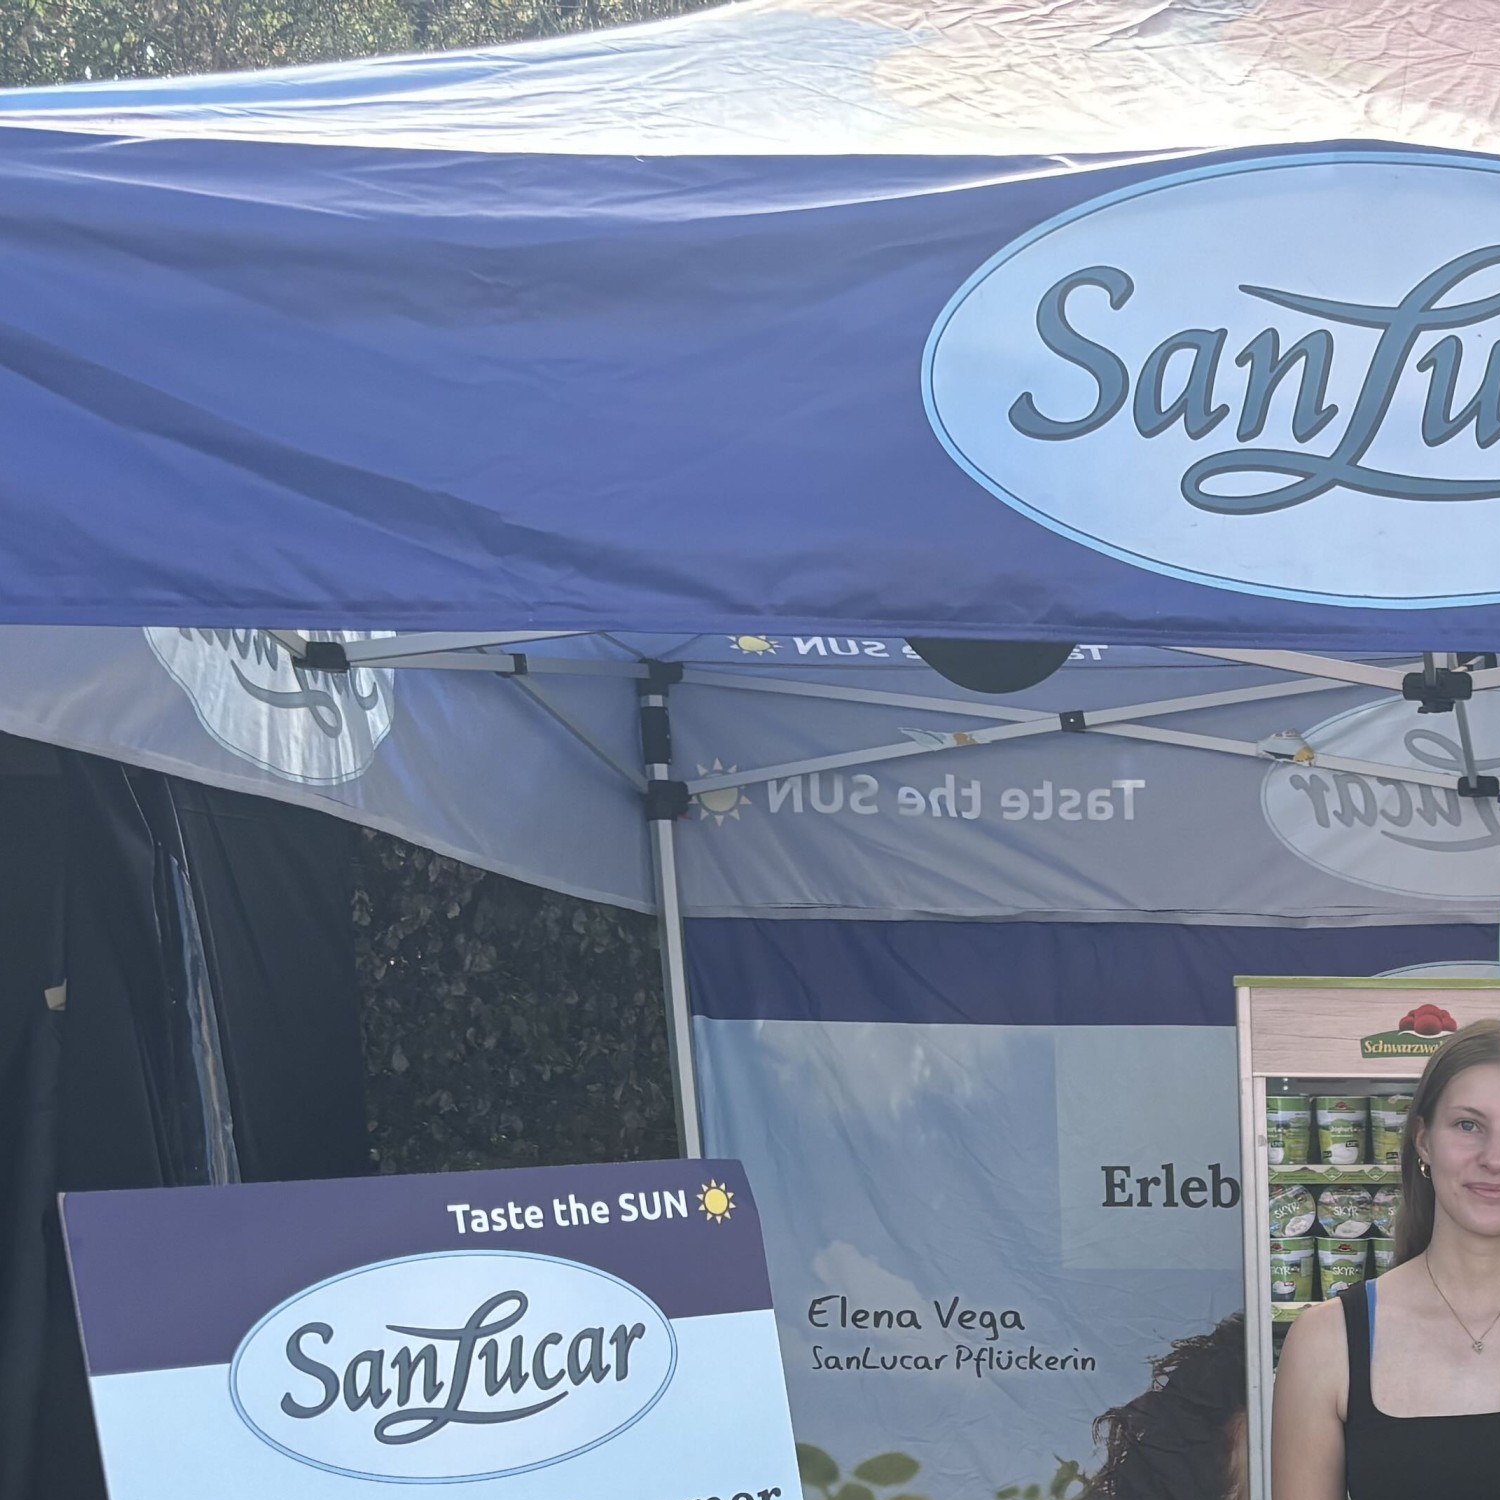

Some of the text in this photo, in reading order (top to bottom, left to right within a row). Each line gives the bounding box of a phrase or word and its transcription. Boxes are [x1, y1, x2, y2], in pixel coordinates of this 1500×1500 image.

[448, 1189, 689, 1234] Taste the SUN
[808, 1295, 1025, 1341] Elena Vega
[281, 1290, 645, 1445] SanLucar
[811, 1344, 1096, 1378] SanLucar Pflückerin
